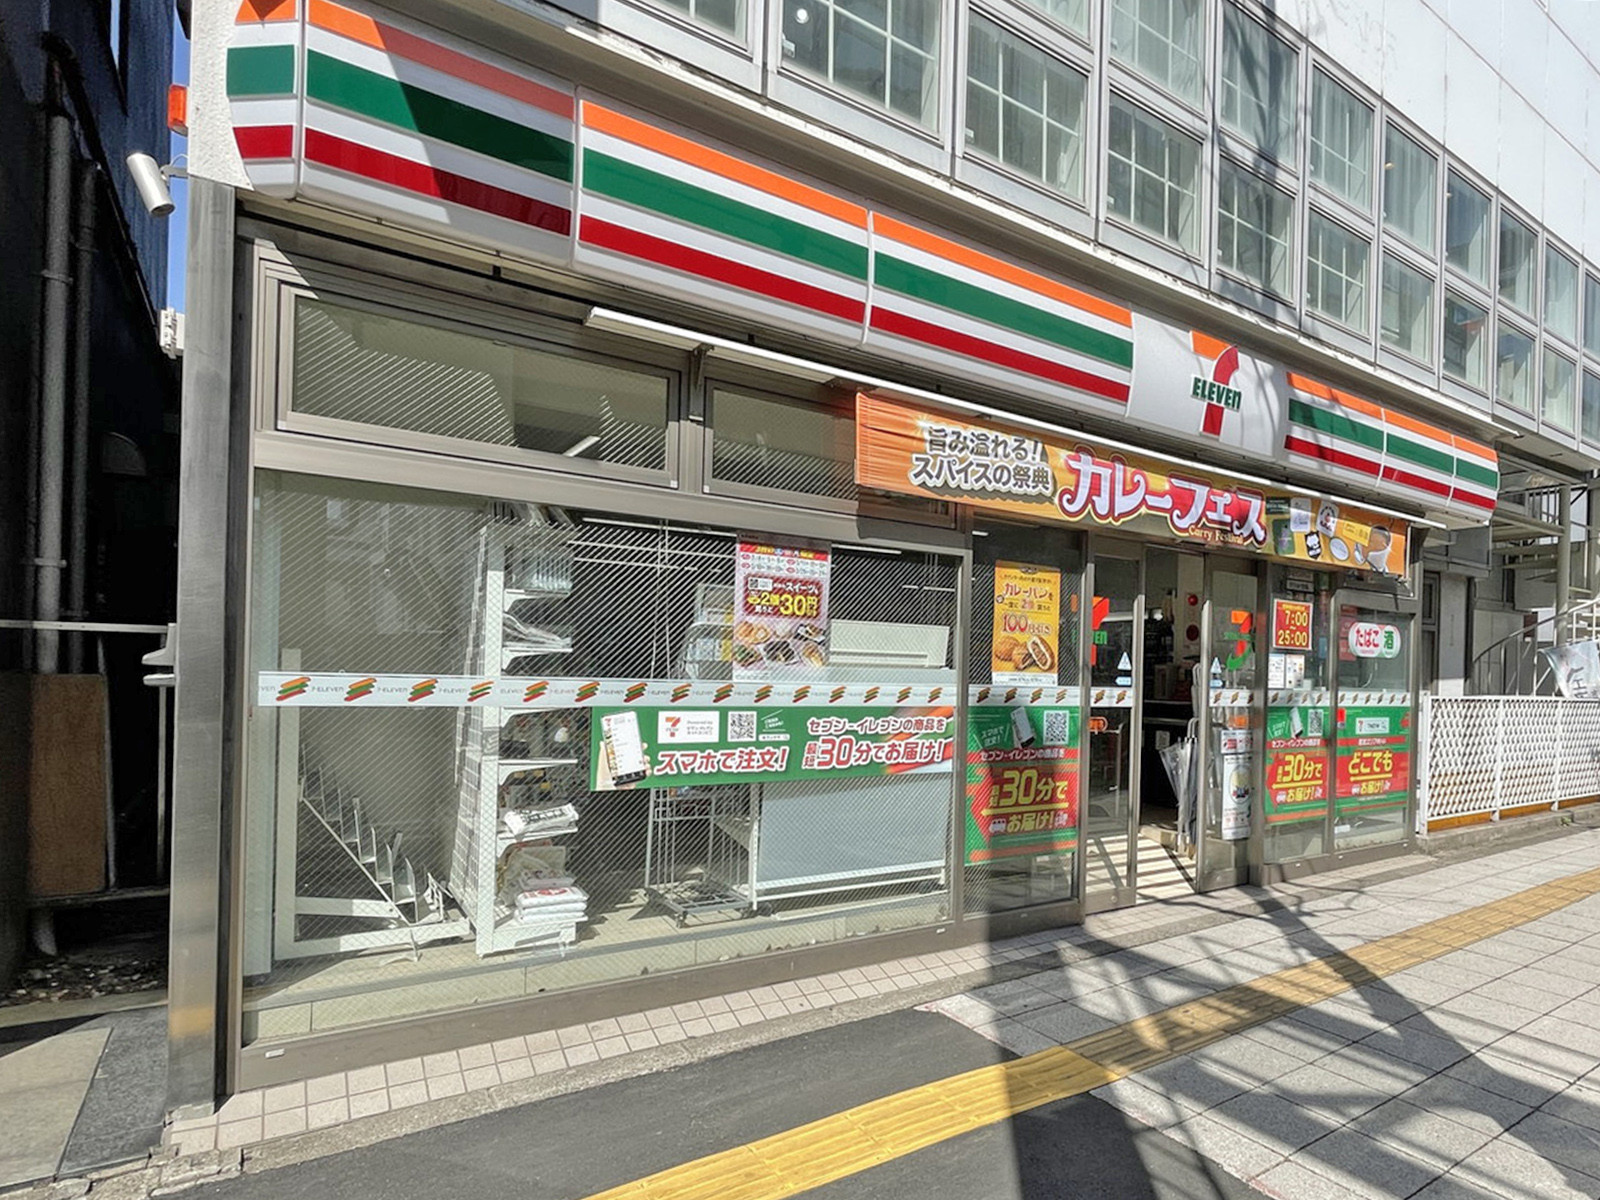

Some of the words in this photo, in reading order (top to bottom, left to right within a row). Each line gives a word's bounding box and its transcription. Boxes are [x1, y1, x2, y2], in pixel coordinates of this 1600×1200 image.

[1192, 376, 1242, 410] ELEVEN
[912, 456, 1051, 490] スパイスの祭典
[1061, 452, 1266, 543] カレーフェス
[1188, 526, 1213, 541] Curry
[1215, 529, 1244, 545] Festival
[1285, 610, 1308, 627] 7:00
[1278, 629, 1308, 646] 25:00
[1355, 628, 1380, 648] たばこ
[1383, 630, 1395, 650] 酒
[656, 748, 788, 773] スマホで注文!
[1348, 750, 1393, 775] どこでも
[1006, 811, 1054, 833] お届け!
